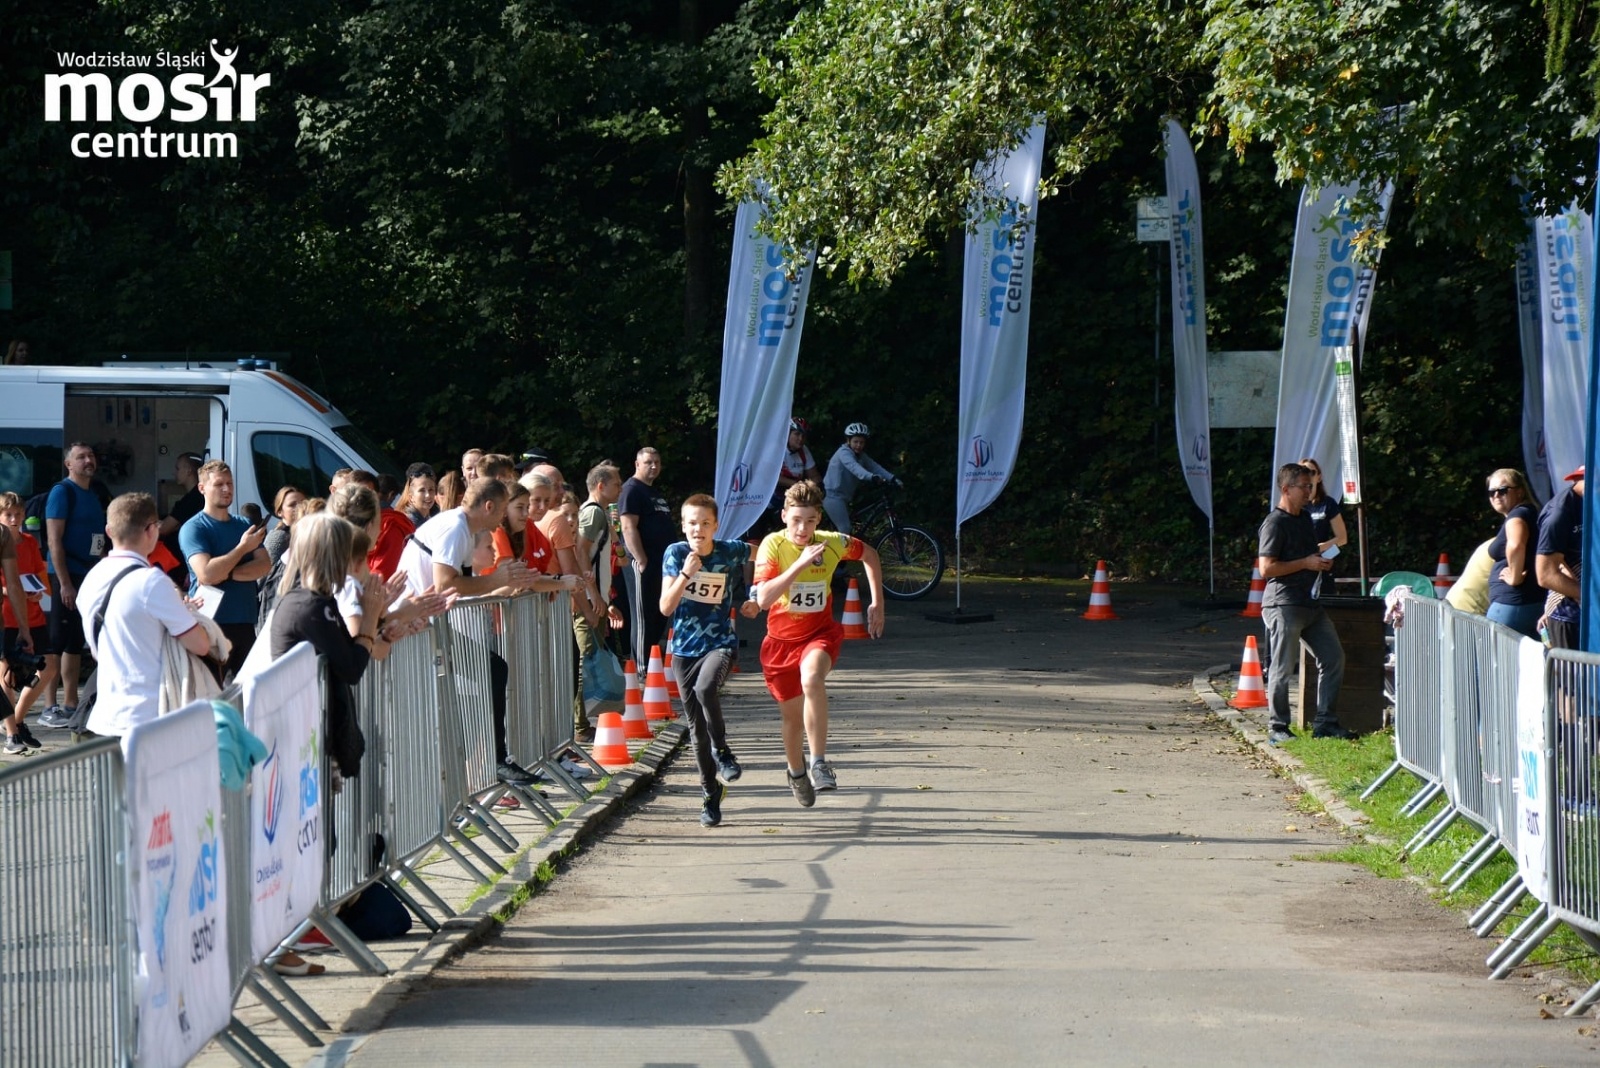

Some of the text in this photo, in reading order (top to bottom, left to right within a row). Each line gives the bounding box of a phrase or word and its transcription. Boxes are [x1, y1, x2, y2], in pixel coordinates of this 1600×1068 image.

[746, 277, 761, 338] Wodzisław
[757, 245, 794, 347] mos
[1308, 236, 1329, 338] Wodzisław Śląski
[685, 581, 722, 598] 457
[791, 591, 824, 607] 451
